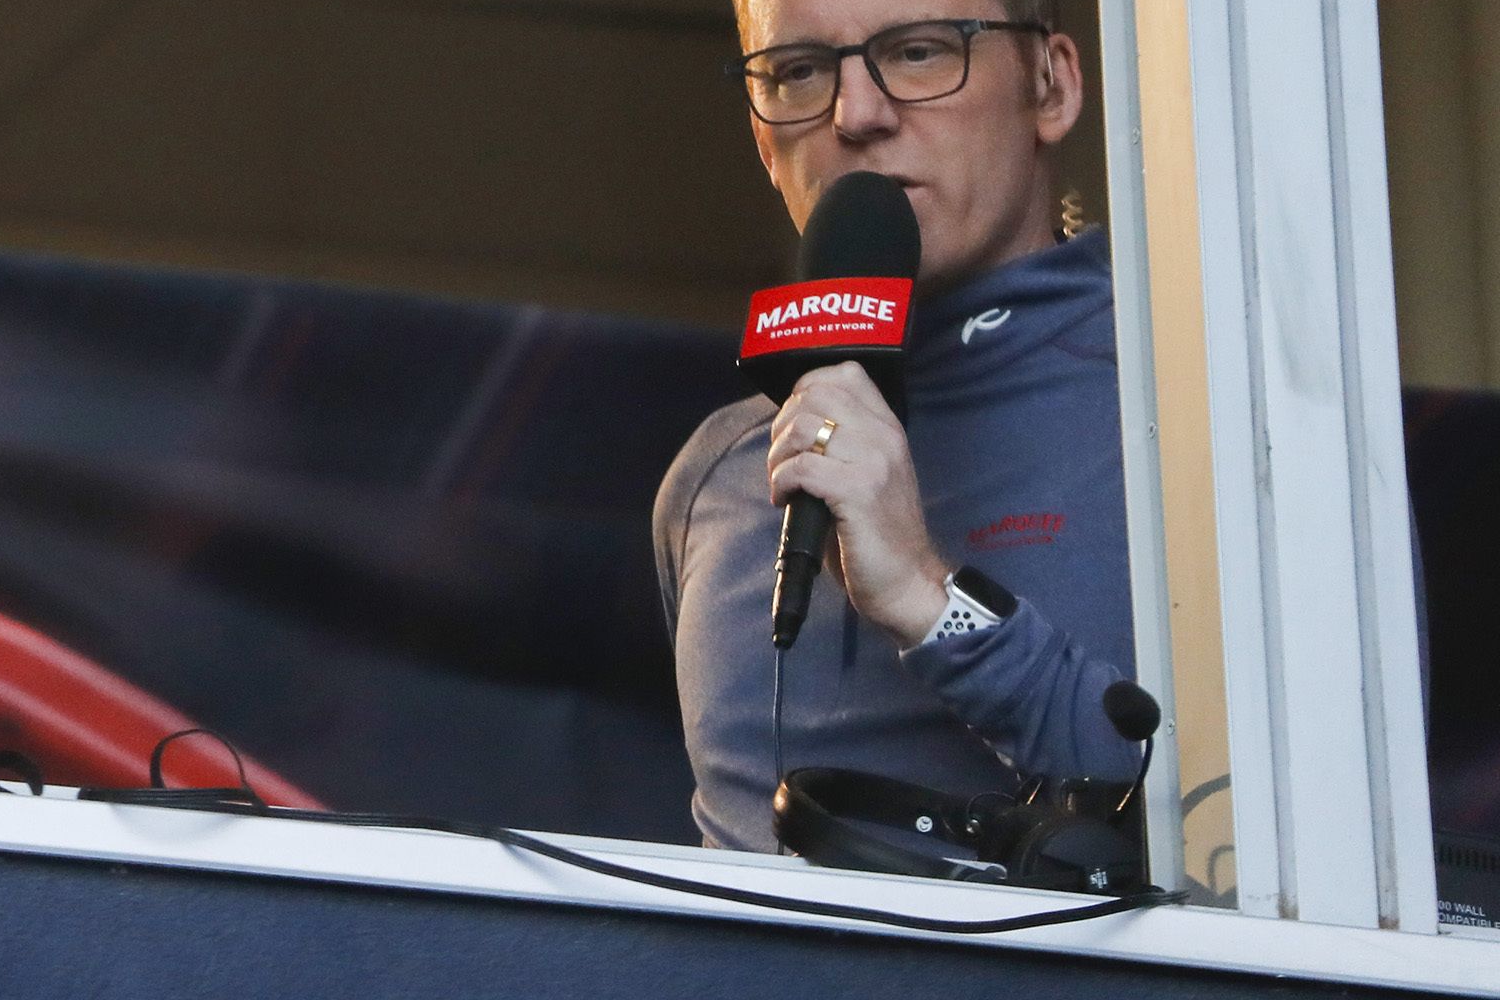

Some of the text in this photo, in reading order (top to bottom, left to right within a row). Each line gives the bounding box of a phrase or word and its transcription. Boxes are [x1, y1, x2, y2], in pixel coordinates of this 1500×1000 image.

[756, 293, 896, 333] MARQUEE
[770, 322, 874, 339] SPORTS NETWORK
[1454, 903, 1486, 917] WALL
